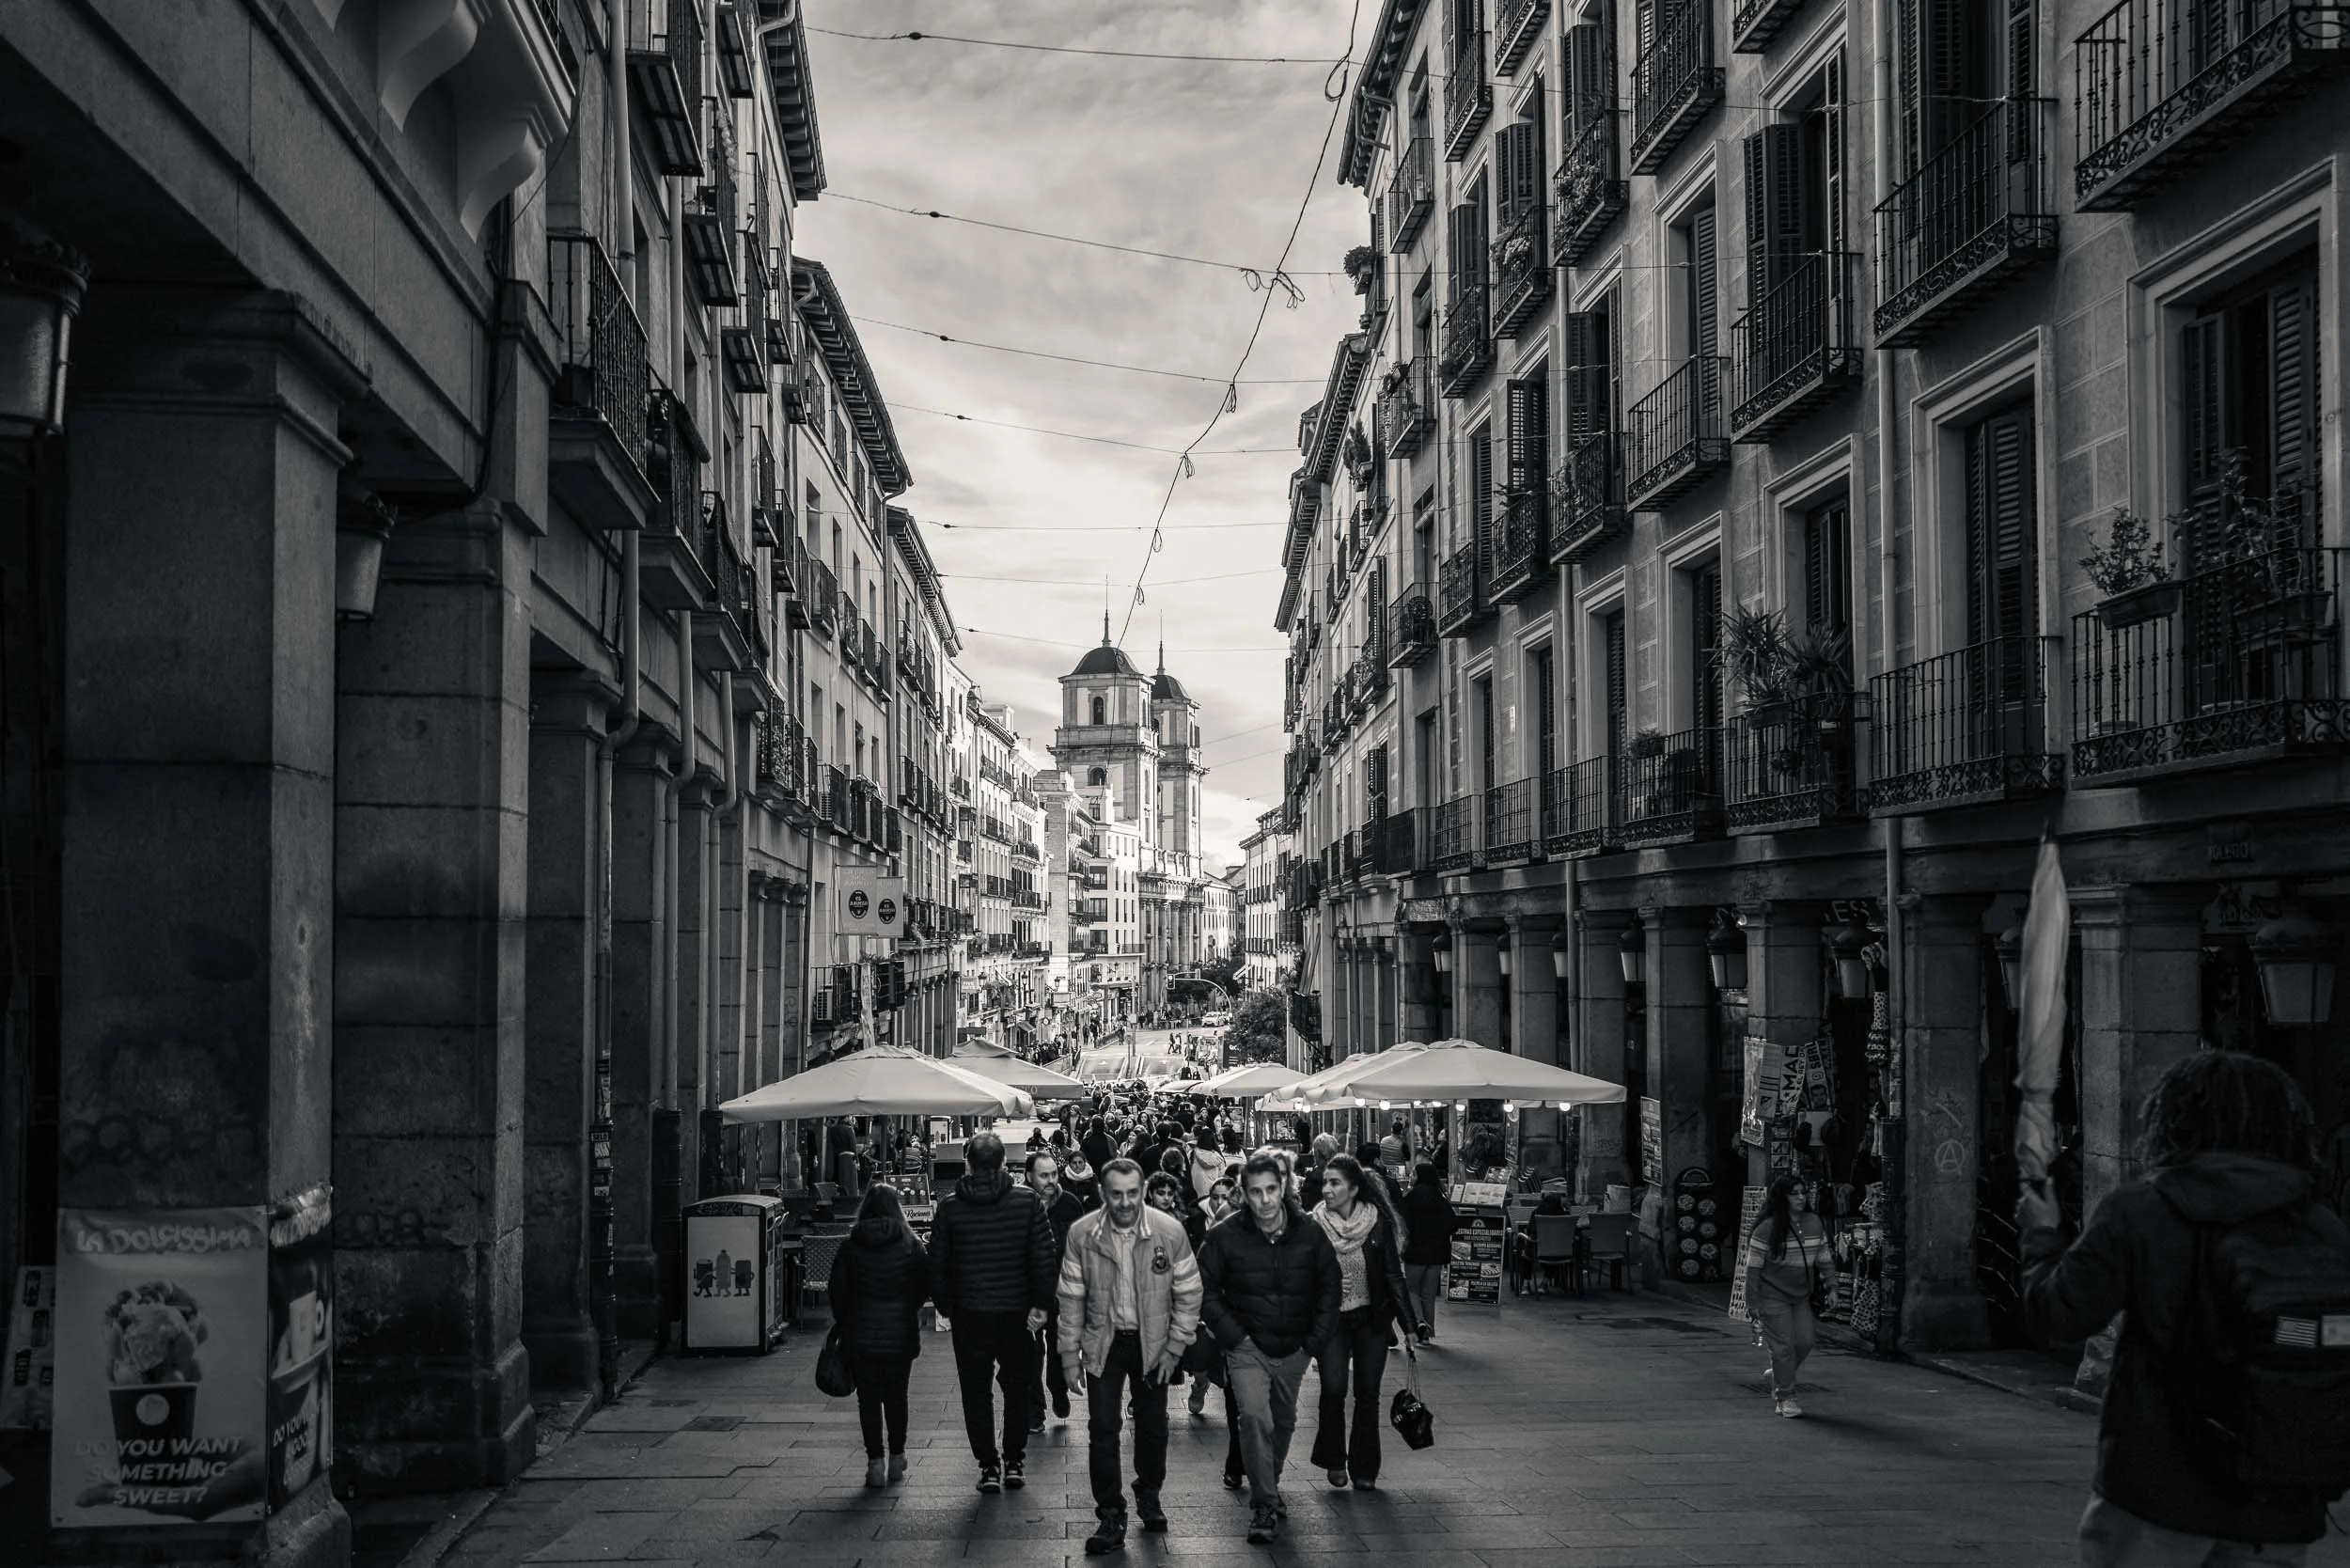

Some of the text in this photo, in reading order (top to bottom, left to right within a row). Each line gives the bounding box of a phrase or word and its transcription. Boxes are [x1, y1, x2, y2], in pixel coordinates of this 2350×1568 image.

[77, 1229, 103, 1253] LA
[74, 1435, 243, 1457] DO YOU WANT
[86, 1457, 228, 1484] SOMETHING
[113, 1486, 209, 1506] SWEET?
